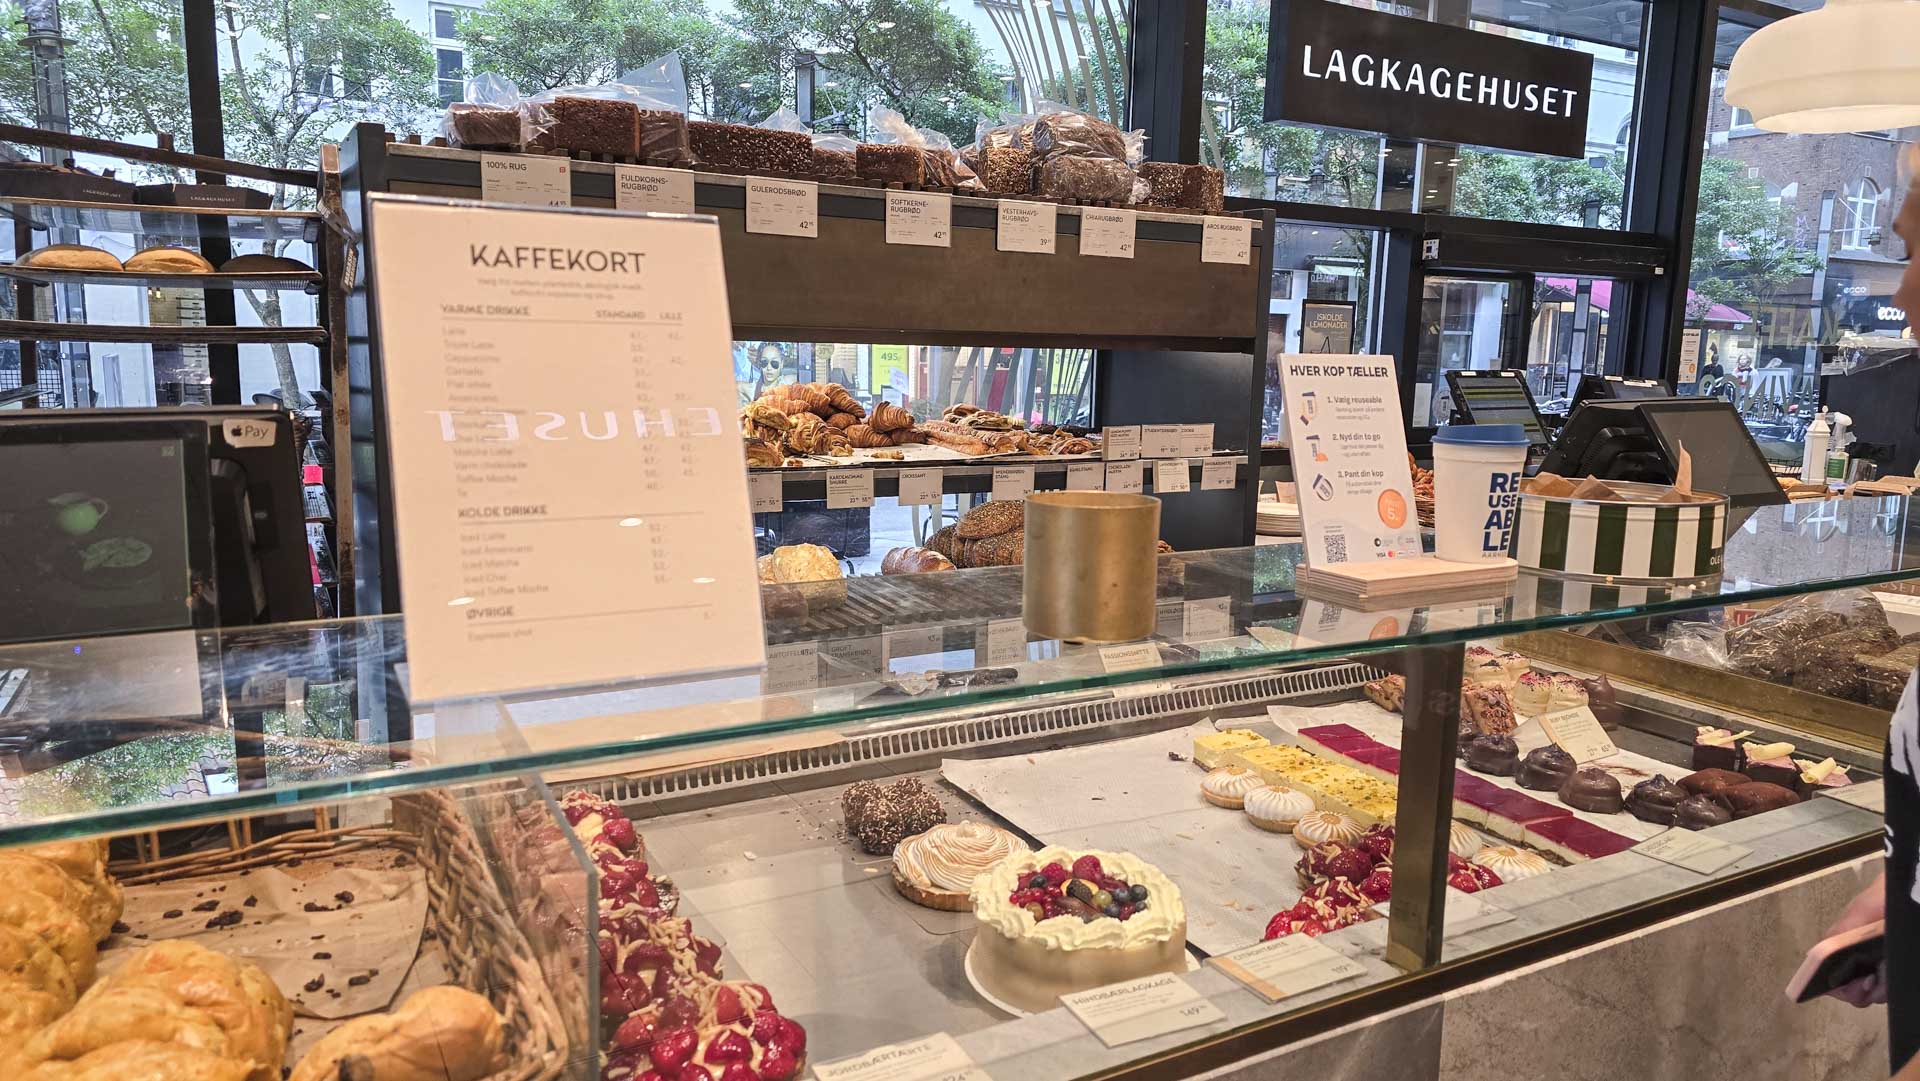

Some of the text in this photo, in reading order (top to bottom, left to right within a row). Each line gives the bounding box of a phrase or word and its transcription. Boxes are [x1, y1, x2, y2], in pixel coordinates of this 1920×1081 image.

[1302, 45, 1577, 118] LAGKAGEHUSET
[486, 161, 527, 171] 100% RUG
[620, 174, 669, 185] FULDKORNS-
[620, 183, 659, 192] RUGBRØD
[750, 185, 807, 197] GULERODSBRØD
[890, 199, 929, 208] SOFTKERNE-
[890, 206, 921, 214] RUGBRØD
[1085, 214, 1124, 222] CHIARUGBRØD
[469, 243, 646, 275] KAFFEKORT
[1843, 286, 1867, 294] ecco
[440, 303, 531, 317] VARME DRIKKE
[596, 310, 646, 320] STANDARD
[1316, 313, 1344, 321] ISKOLDE
[1309, 320, 1348, 329] LEMONADER
[1290, 365, 1389, 378] HVER KOP TÆLLER
[245, 426, 269, 439] Pay
[1344, 470, 1360, 478] Pant
[1360, 470, 1371, 478] din
[1489, 472, 1521, 493] RE
[1488, 494, 1517, 508] USE
[458, 504, 549, 518] KOLDE DRIKKE
[1484, 509, 1514, 530] AB
[1483, 531, 1510, 551] LE
[1710, 556, 1721, 566] OLE
[465, 606, 514, 620] ØVRIGE
